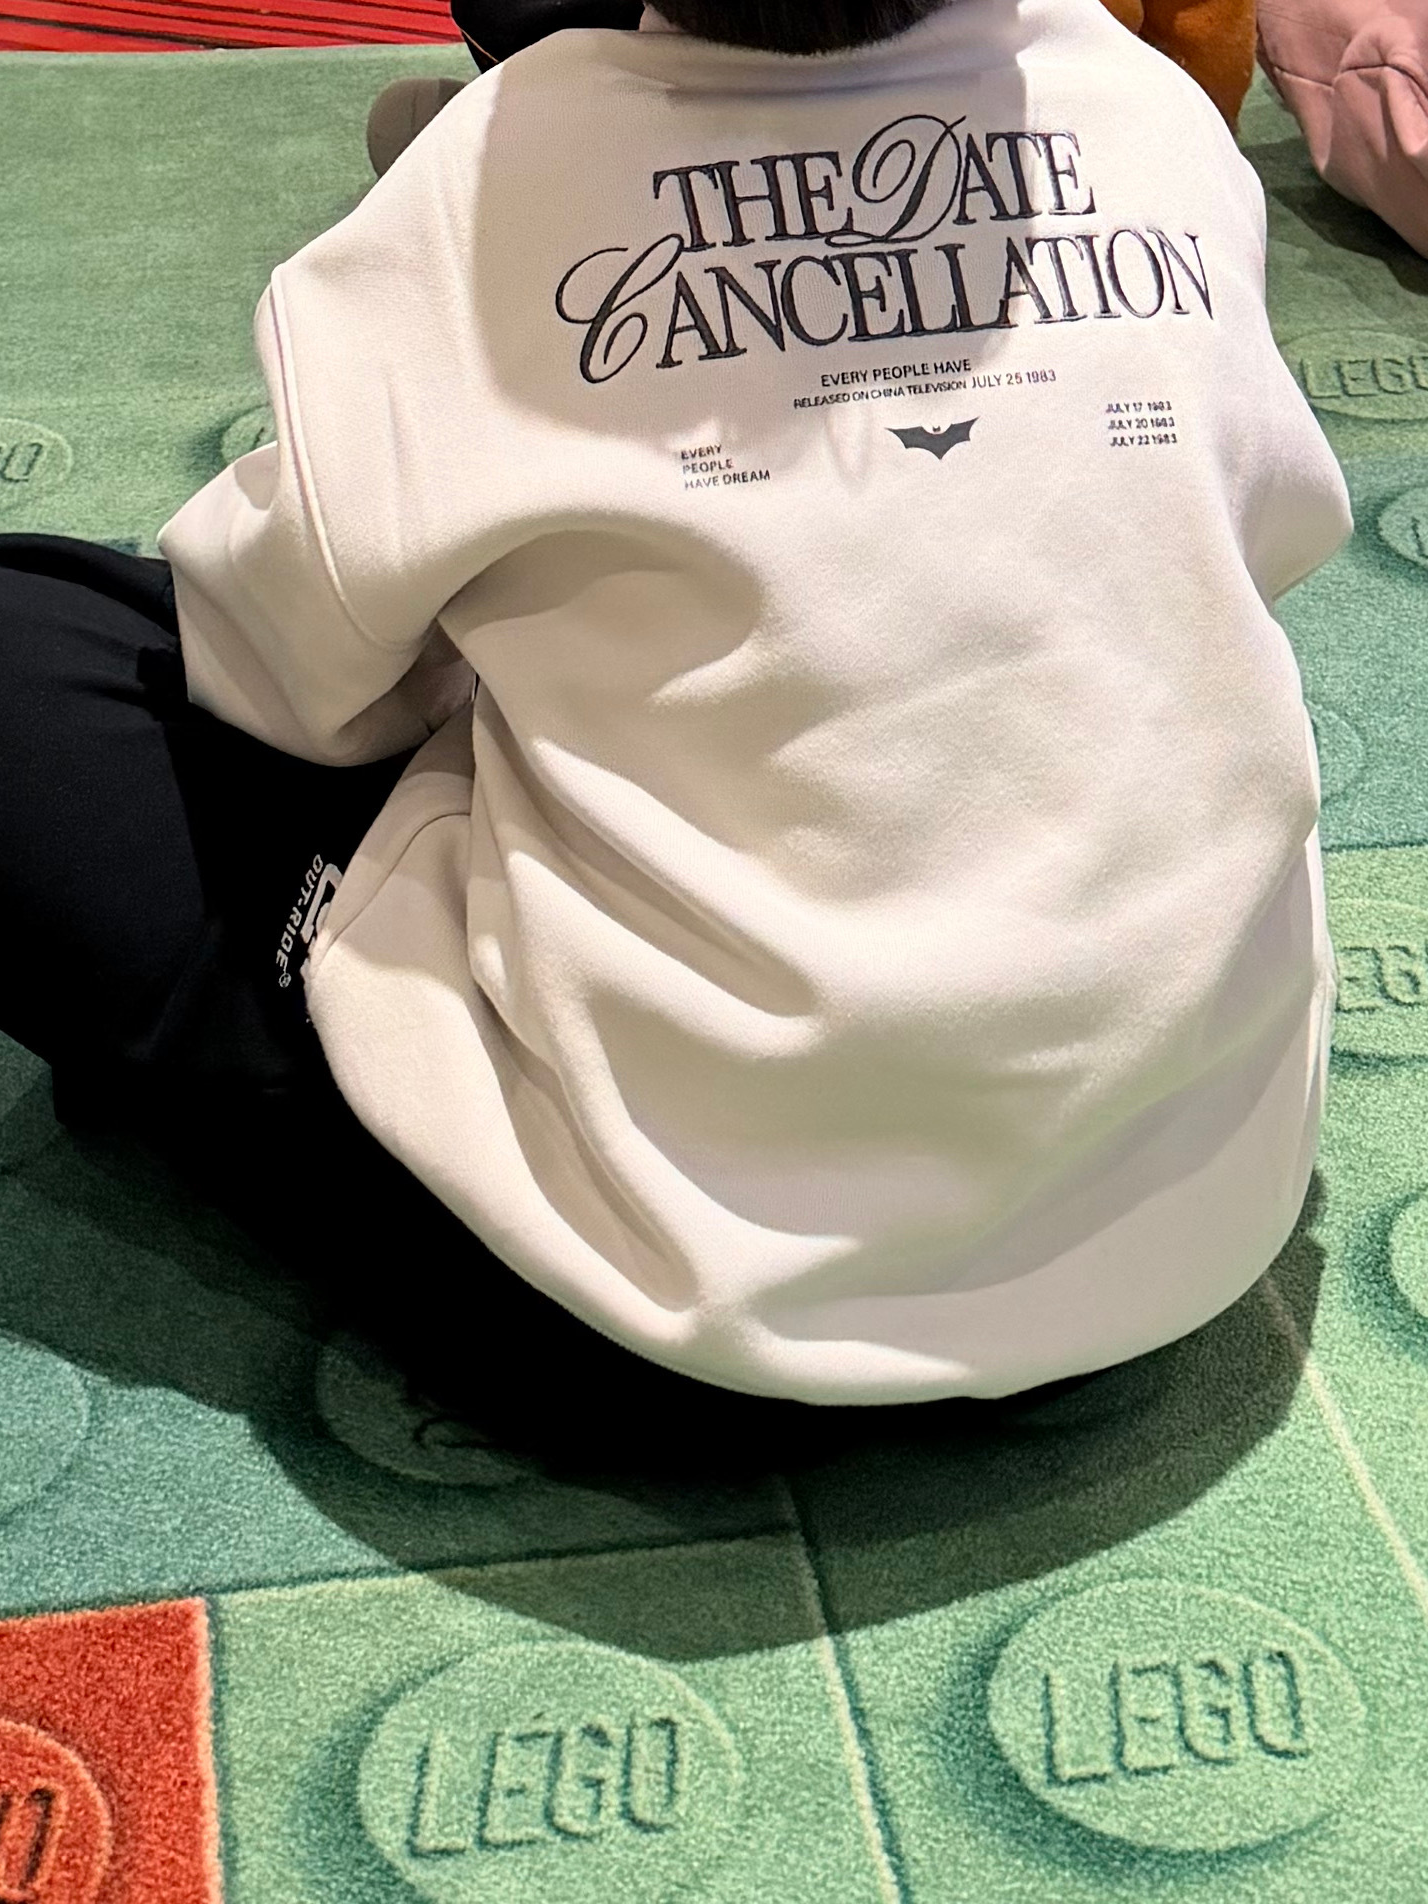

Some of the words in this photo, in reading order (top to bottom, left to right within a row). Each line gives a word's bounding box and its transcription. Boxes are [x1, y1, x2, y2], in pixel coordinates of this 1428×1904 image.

[653, 151, 855, 253] THE
[825, 114, 1095, 247] DATE
[555, 228, 1215, 384] CANCELLATION
[793, 393, 850, 410] RELEASED
[852, 390, 869, 402] ON
[871, 386, 906, 400] CHINA
[907, 379, 967, 397] TELEVISION
[971, 373, 1002, 389] JULY
[1026, 369, 1057, 384] 1983
[820, 369, 868, 388] EVERY
[872, 362, 930, 382] PEOPLE
[934, 358, 972, 374] HAVE
[680, 444, 722, 461] EVERY
[682, 458, 734, 475] PEOPLE
[684, 475, 720, 491] HAVE
[722, 469, 771, 486] DREAM
[1042, 1649, 1314, 1789] LEGO
[409, 1716, 680, 1858] LEGO
